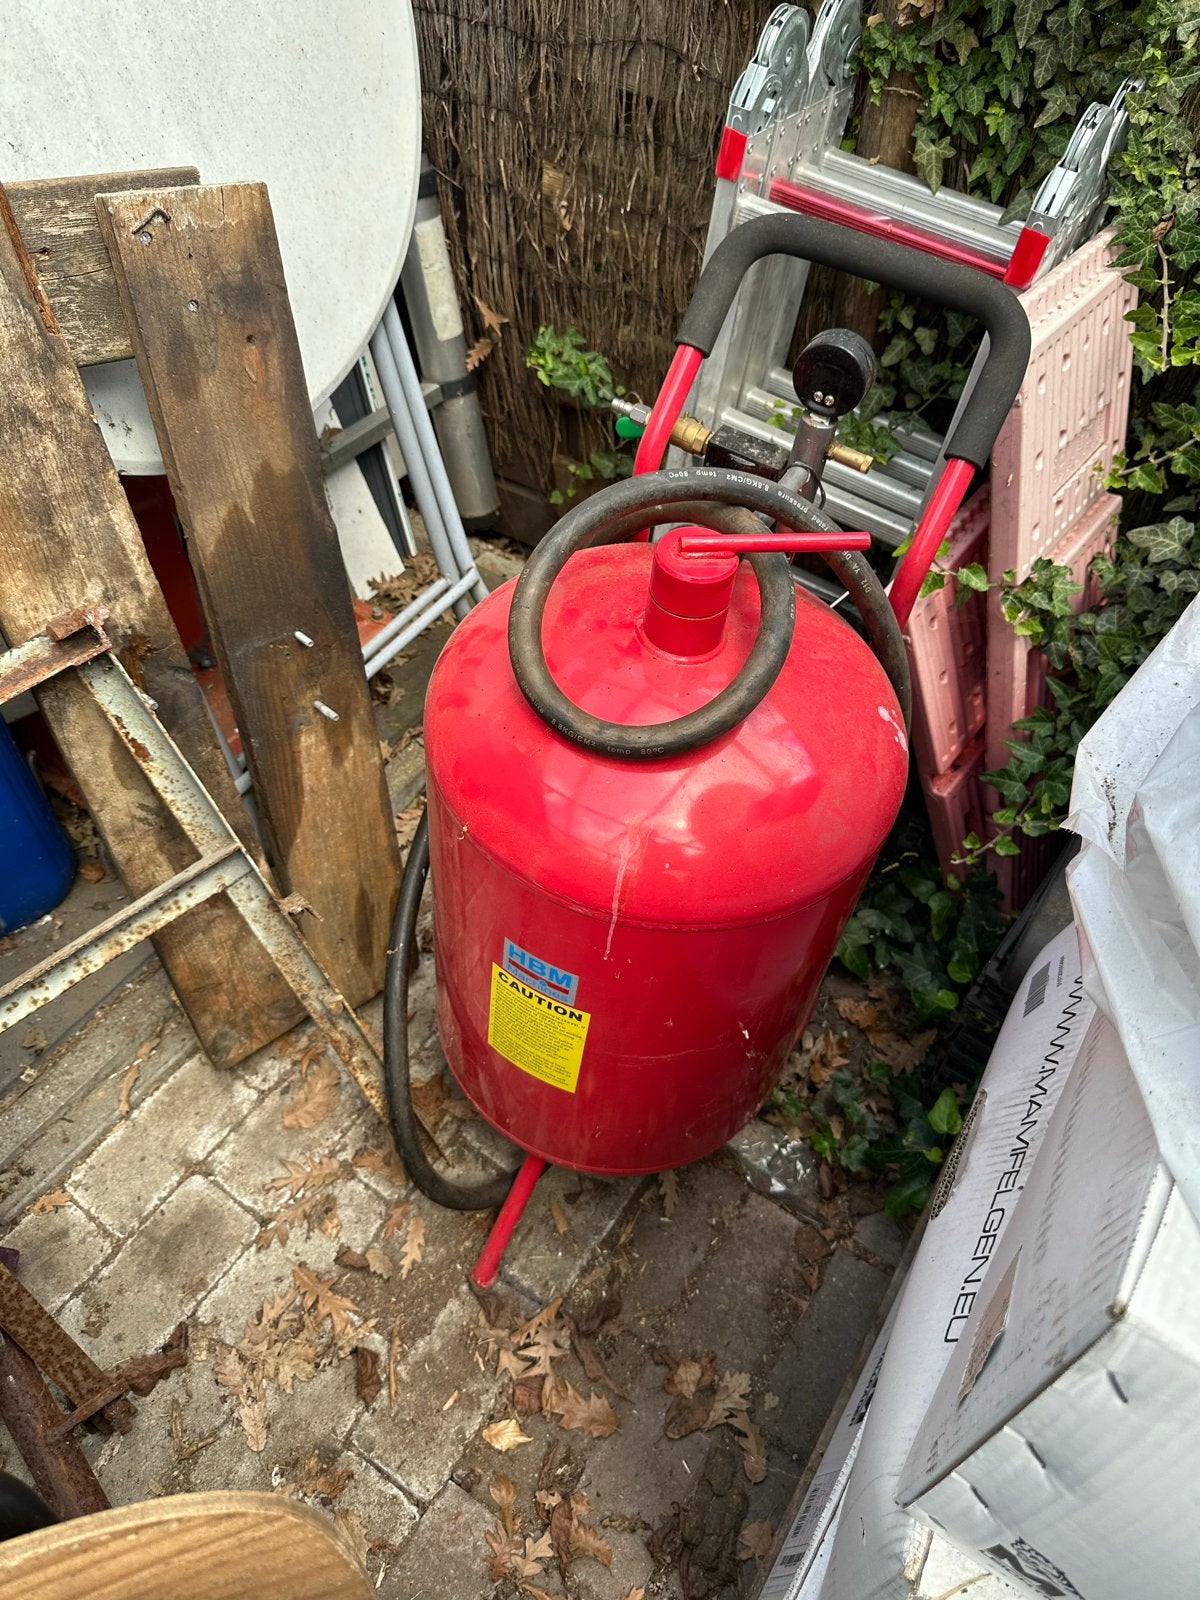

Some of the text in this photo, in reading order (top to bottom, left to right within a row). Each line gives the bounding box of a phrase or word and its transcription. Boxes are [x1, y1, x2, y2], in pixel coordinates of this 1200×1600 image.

[777, 490, 809, 513] pressure
[811, 514, 829, 531] rated
[607, 746, 631, 755] temp
[508, 943, 572, 989] HBM
[498, 971, 583, 1022] CAUTION
[506, 964, 569, 1003] Machines
